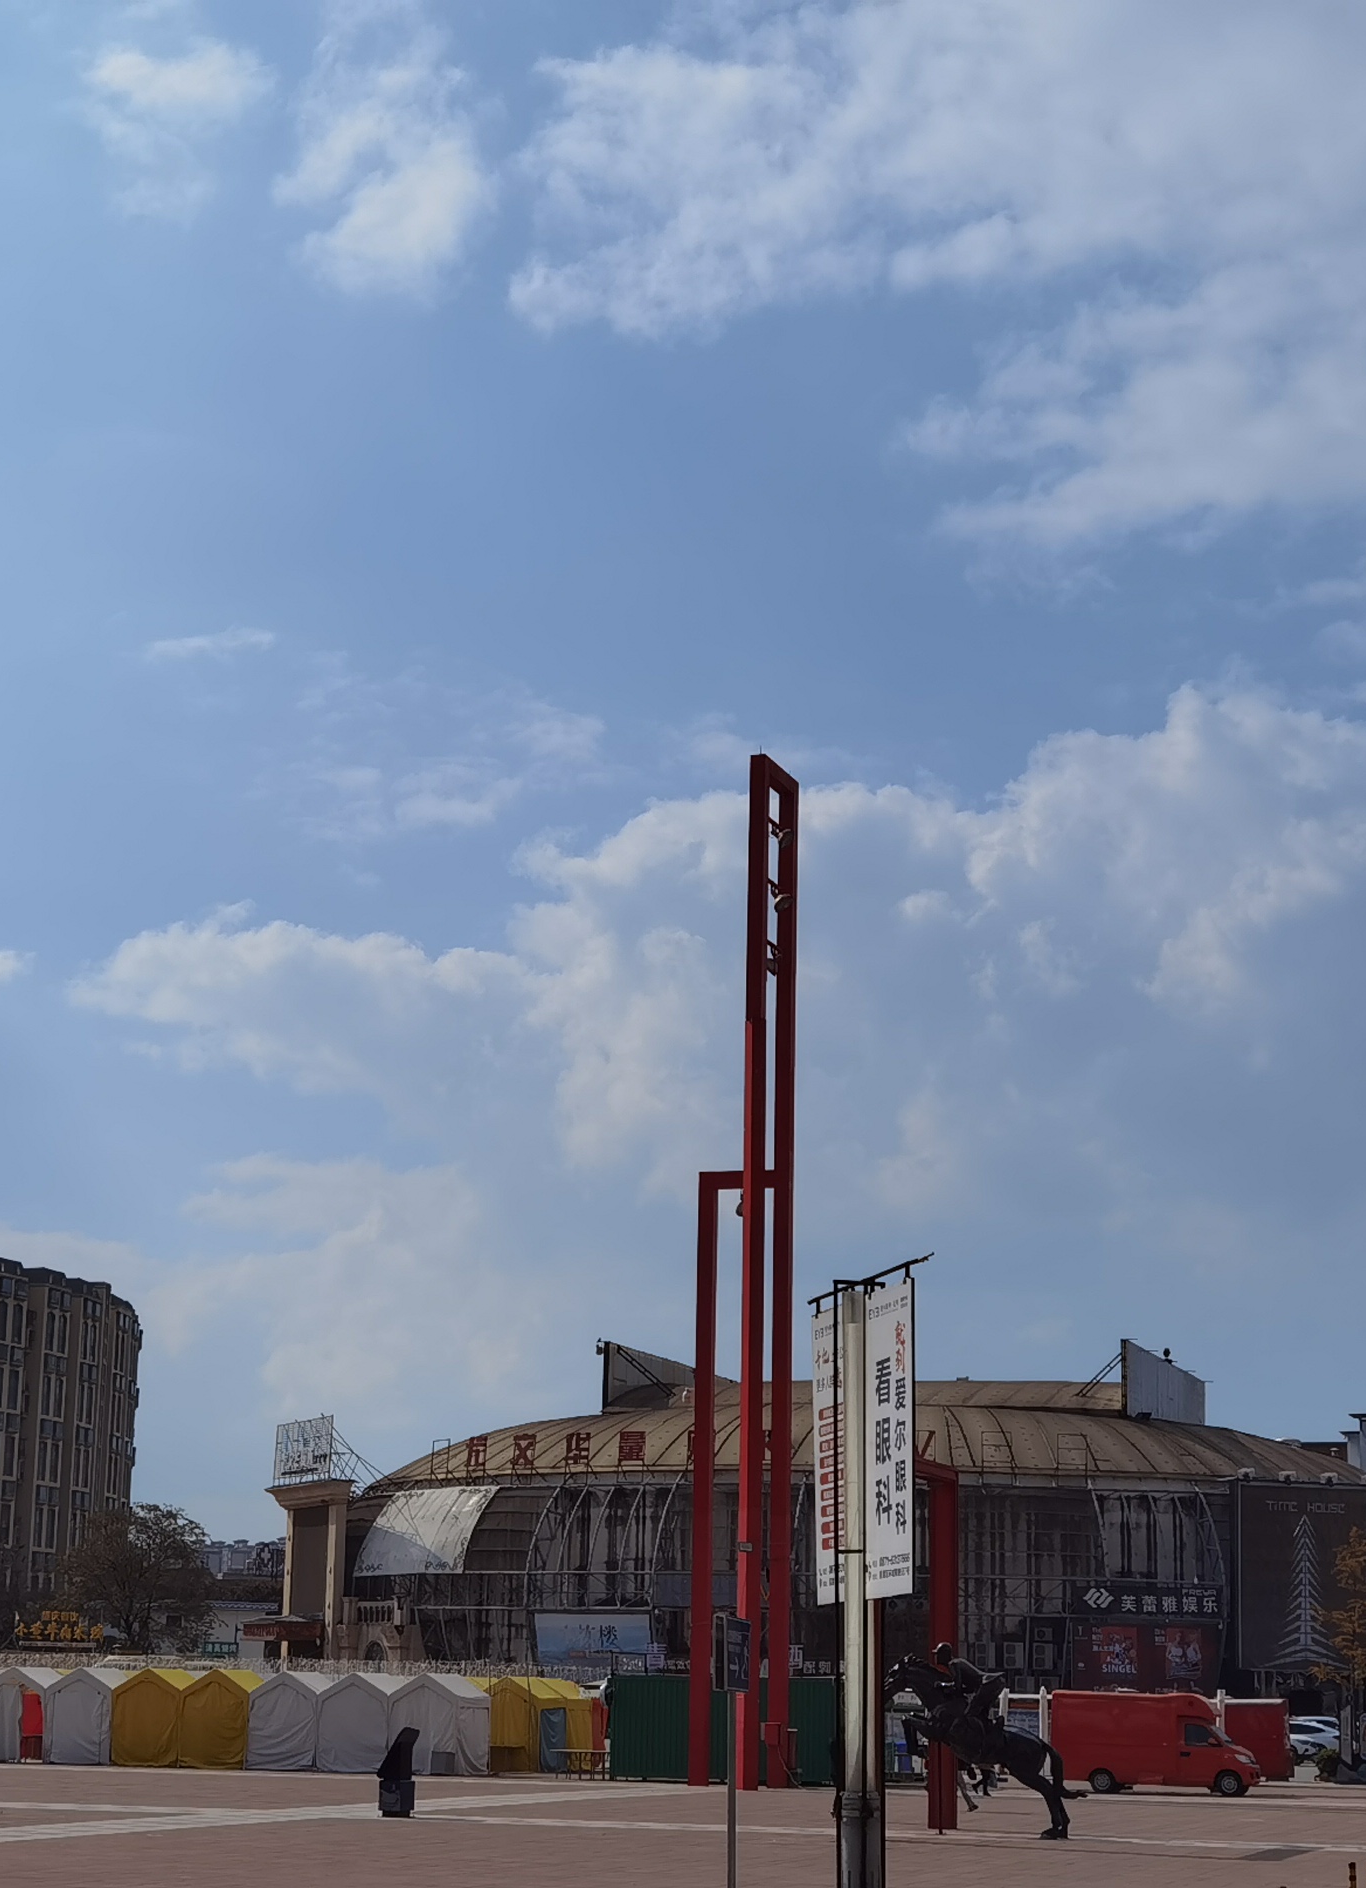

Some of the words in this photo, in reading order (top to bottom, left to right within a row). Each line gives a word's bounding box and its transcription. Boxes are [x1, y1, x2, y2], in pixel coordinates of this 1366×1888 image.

[874, 1356, 892, 1527] 看眼科
[1120, 1594, 1218, 1613] 芙蕾雅娱乐
